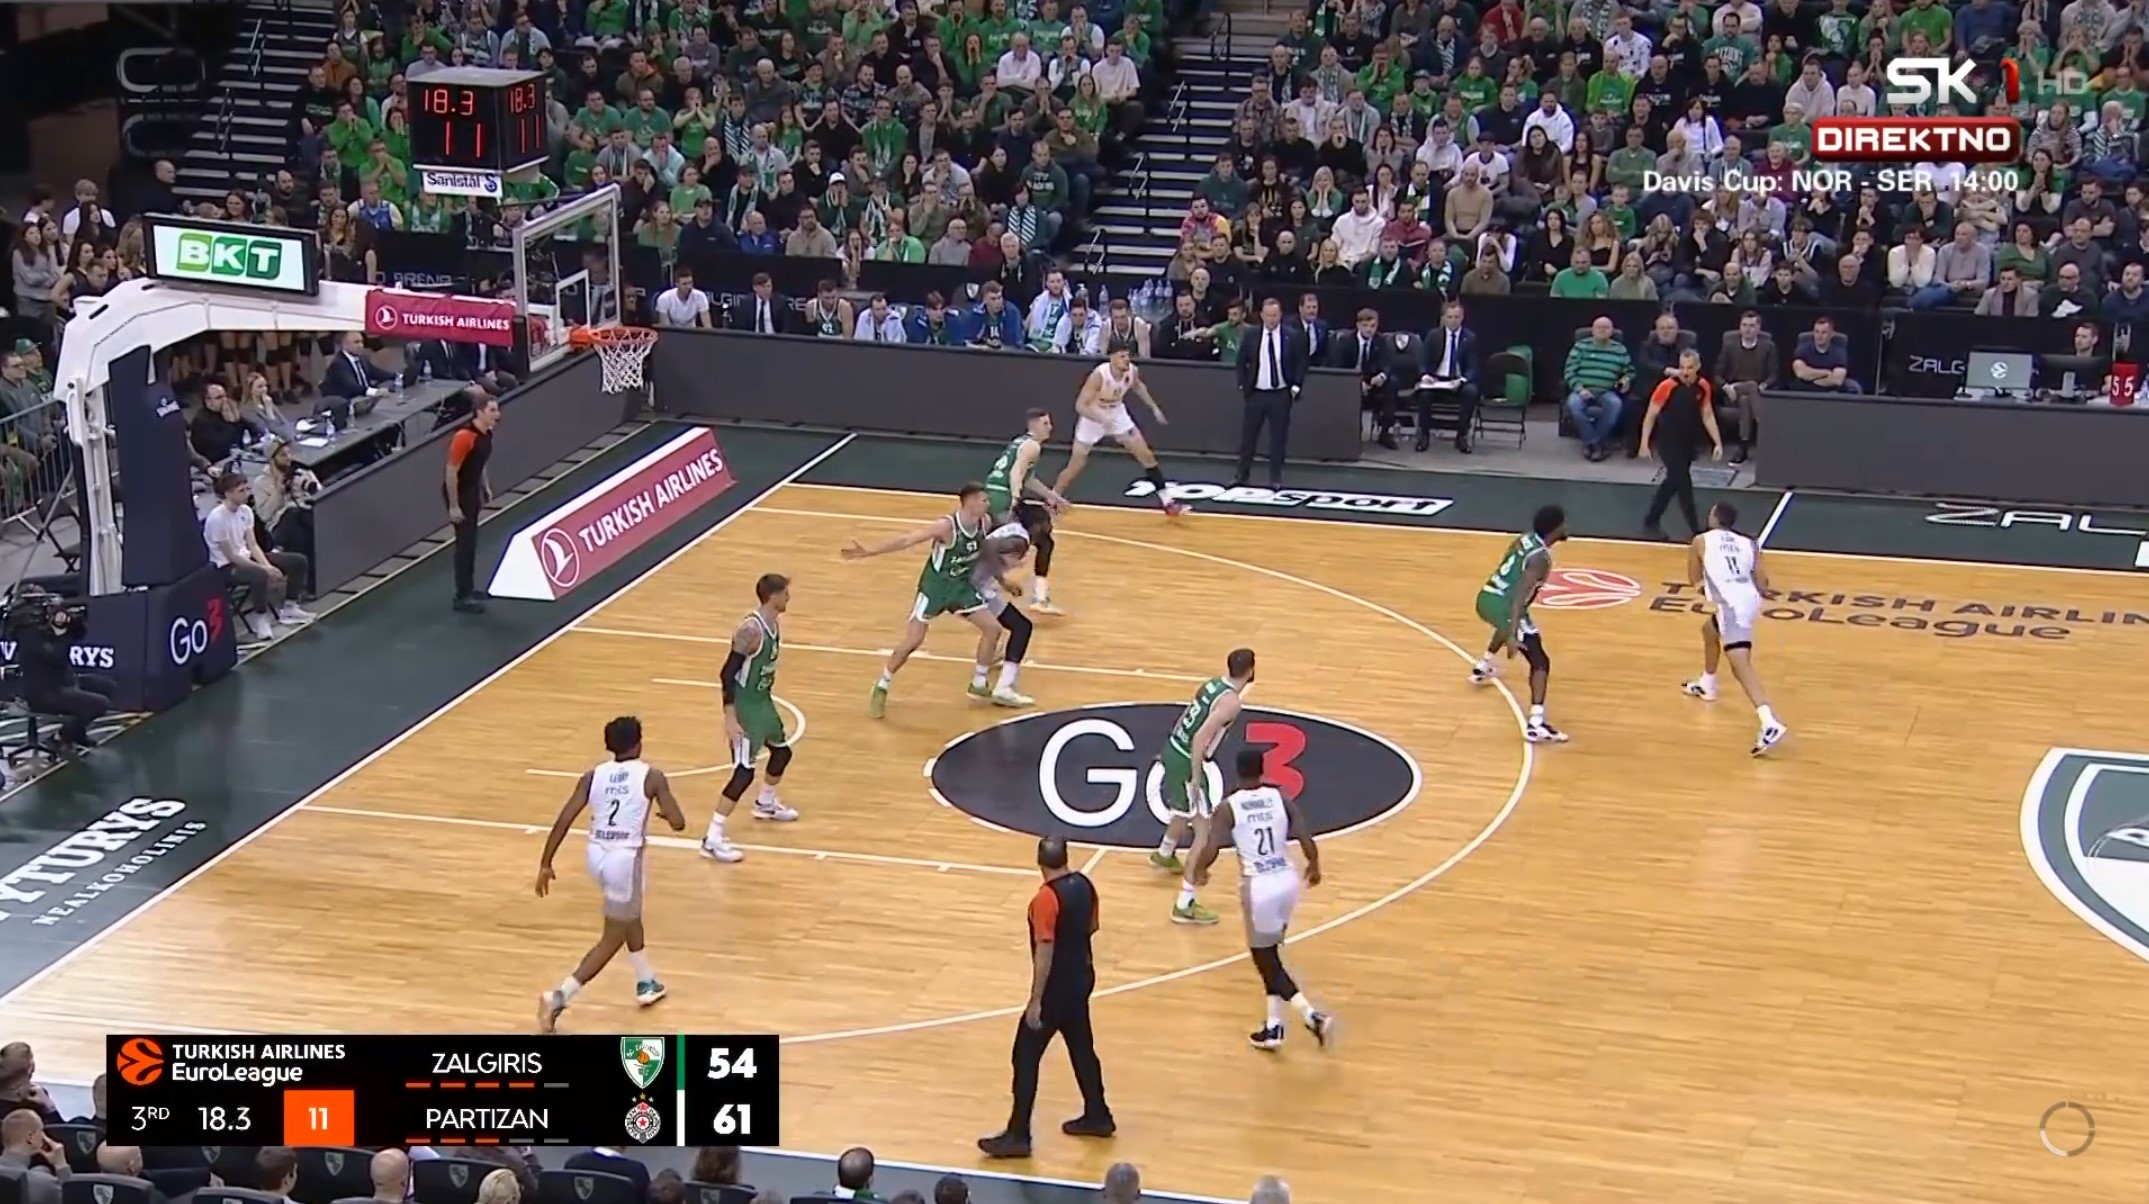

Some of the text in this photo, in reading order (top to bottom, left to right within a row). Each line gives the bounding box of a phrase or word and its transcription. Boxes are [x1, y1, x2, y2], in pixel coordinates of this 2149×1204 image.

[424, 88, 474, 116] 18.3
[509, 82, 536, 114] 18.3
[444, 120, 483, 159] 11
[176, 232, 283, 281] BKT
[402, 312, 511, 331] TURKISH AIRLINES
[1908, 355, 1965, 374] ZALG
[578, 448, 724, 552] TURKISH AIRLINES
[1660, 581, 1935, 612] TKISH
[170, 597, 222, 665] Go3
[1649, 597, 2071, 640] EuoLeague
[1038, 718, 1307, 828] Go3
[607, 799, 620, 826] 2
[1254, 826, 1275, 856] 21
